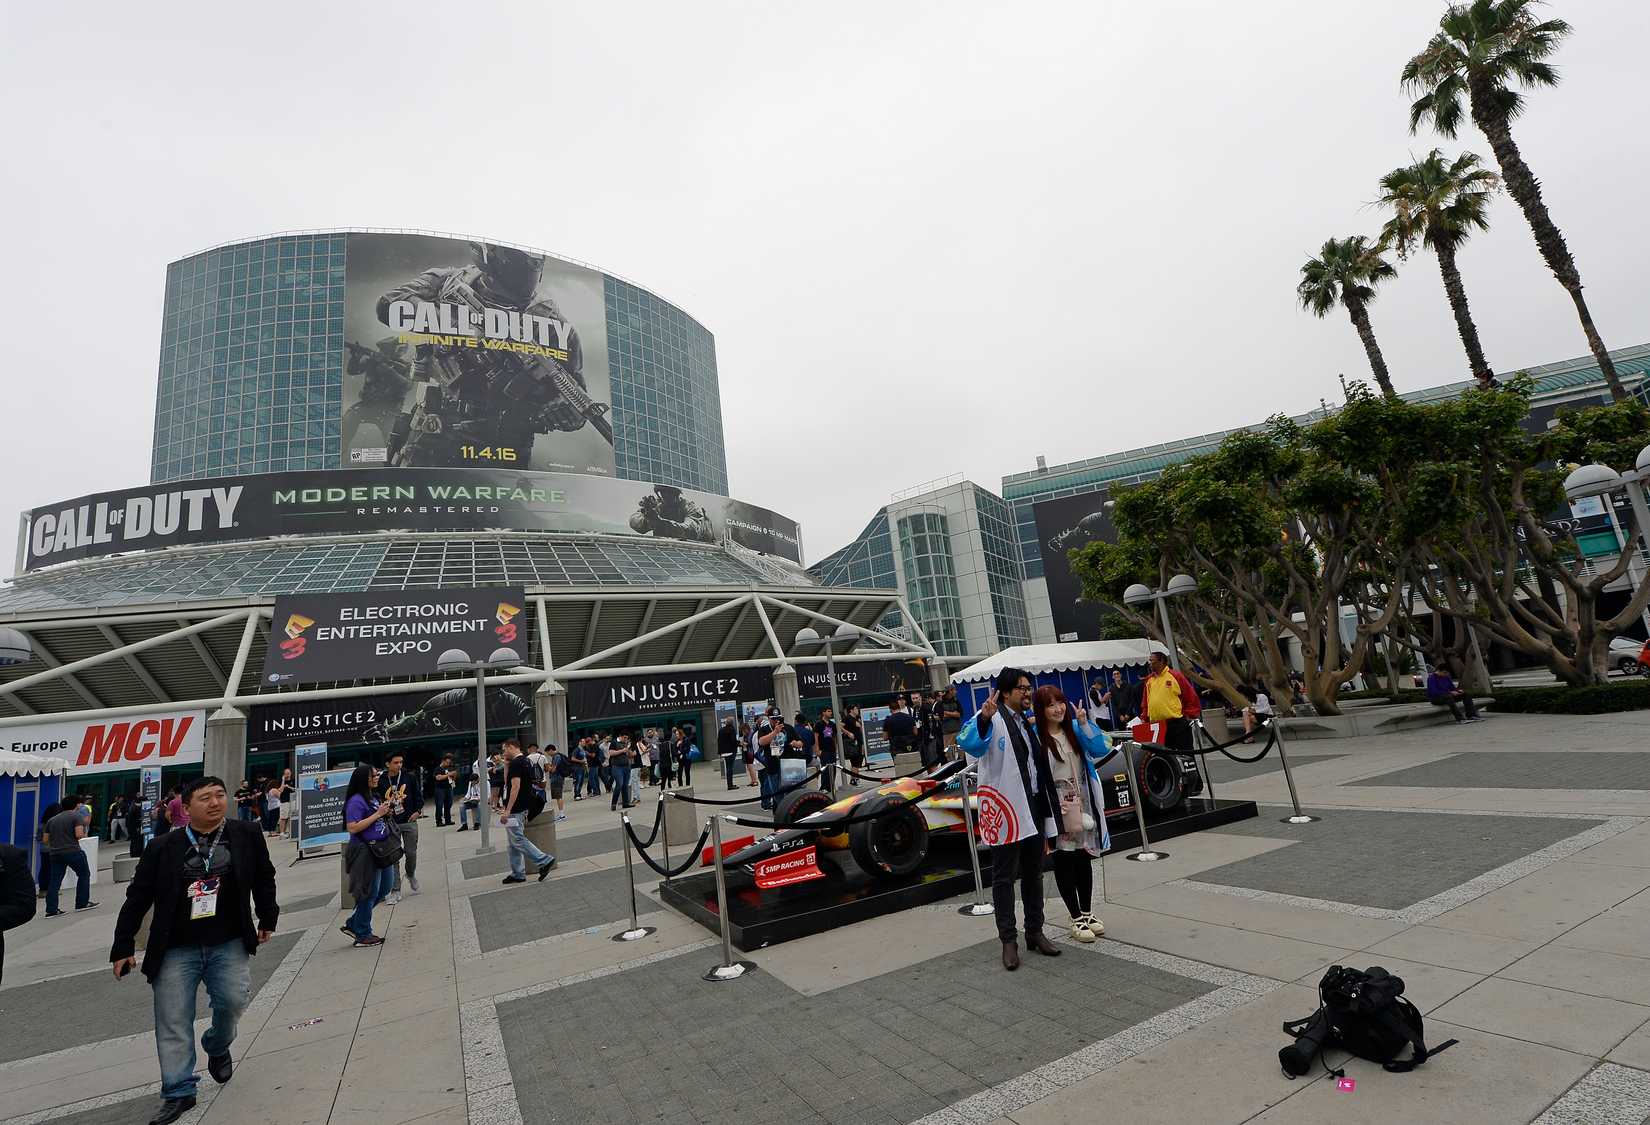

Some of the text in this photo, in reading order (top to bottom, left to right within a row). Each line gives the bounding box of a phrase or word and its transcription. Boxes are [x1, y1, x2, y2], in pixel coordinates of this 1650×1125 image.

[388, 300, 573, 351] CALL OF DUTY
[398, 334, 569, 362] INFINITE WARFARE
[460, 444, 517, 461] 11.4.16
[274, 485, 566, 505] MODERN WARFARE
[356, 505, 500, 515] REMASTERED
[31, 485, 244, 557] CALL OF DUTY
[726, 518, 762, 533] CAMPAIGN
[339, 602, 469, 621] ELECTRONIC
[316, 618, 489, 641] ENTERTAINMENT
[375, 640, 432, 656] EXPO
[75, 716, 195, 767] MCV
[1150, 722, 1160, 743] 7
[11, 740, 68, 753] Europe
[782, 839, 805, 849] PS4
[765, 864, 781, 874] SMP
[780, 858, 805, 870] RACING
